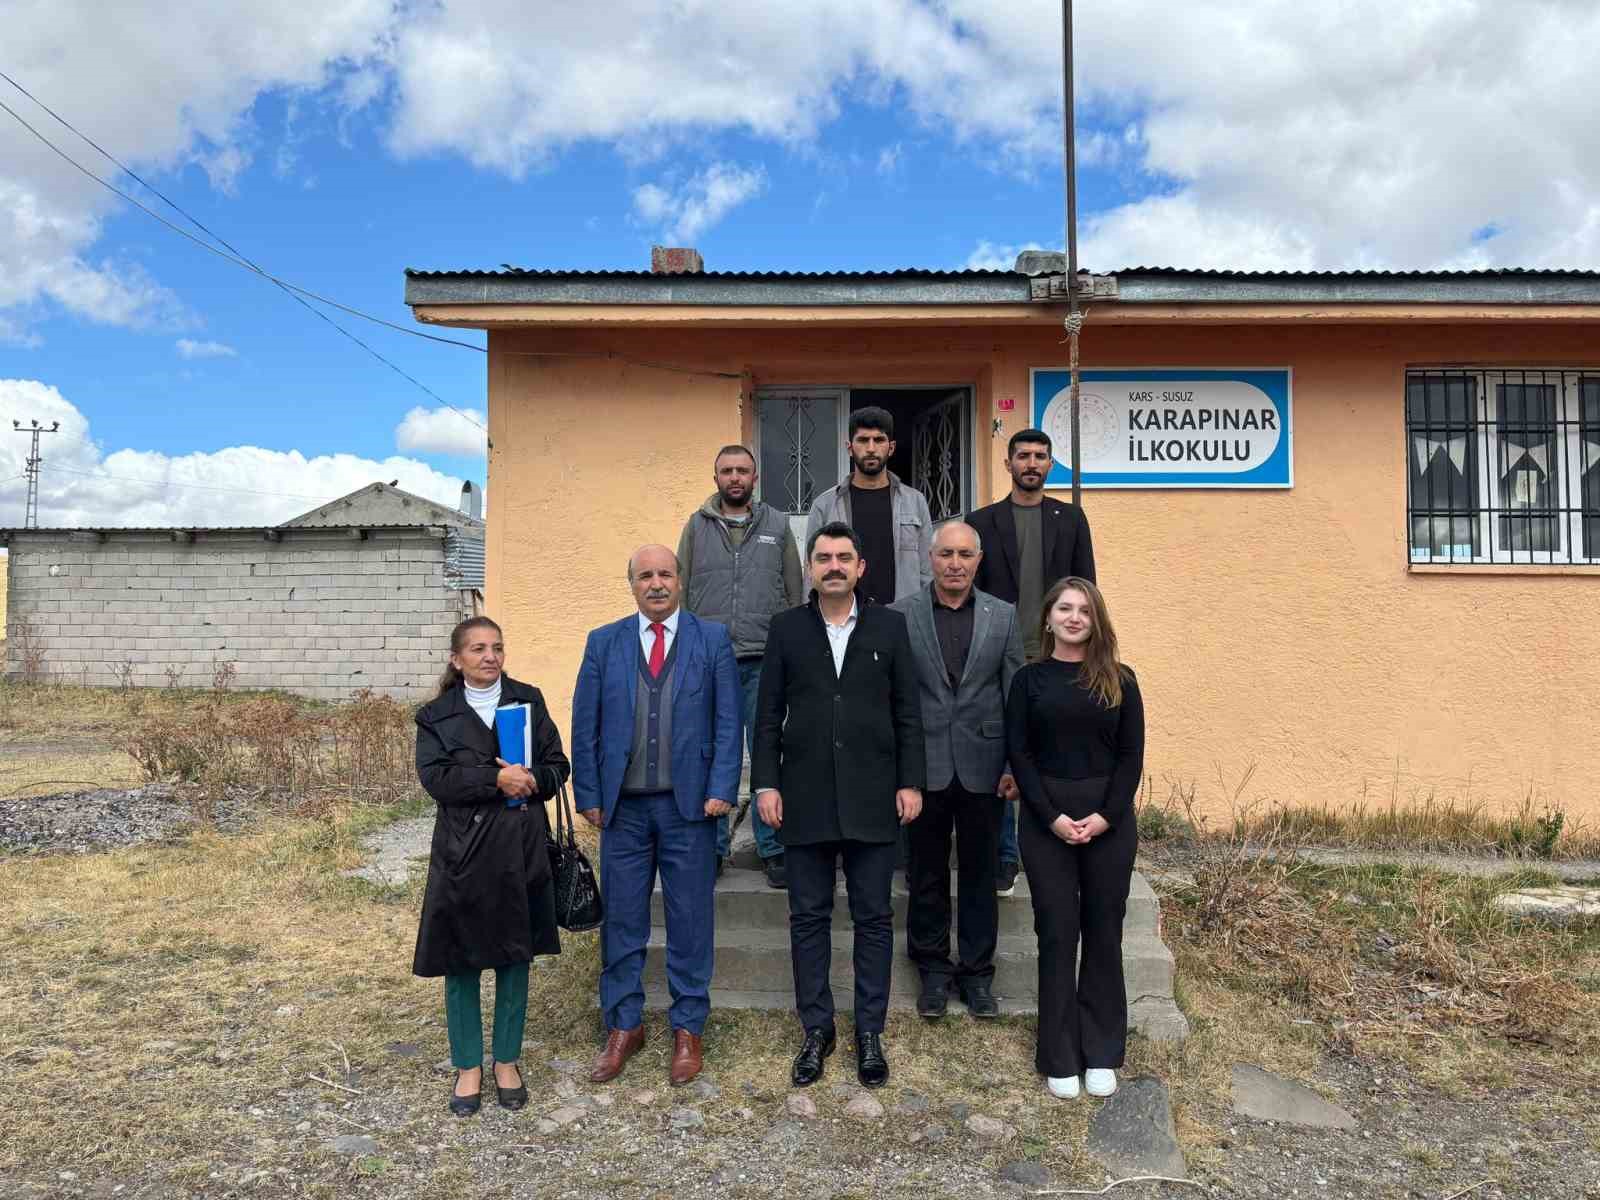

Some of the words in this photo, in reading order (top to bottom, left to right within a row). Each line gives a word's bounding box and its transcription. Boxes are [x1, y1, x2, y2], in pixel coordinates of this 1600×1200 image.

[1128, 391, 1153, 402] KARS
[1162, 391, 1193, 402] SUSUZ
[1128, 408, 1277, 431] KARAPINAR
[1129, 435, 1250, 462] İLKOKULU
